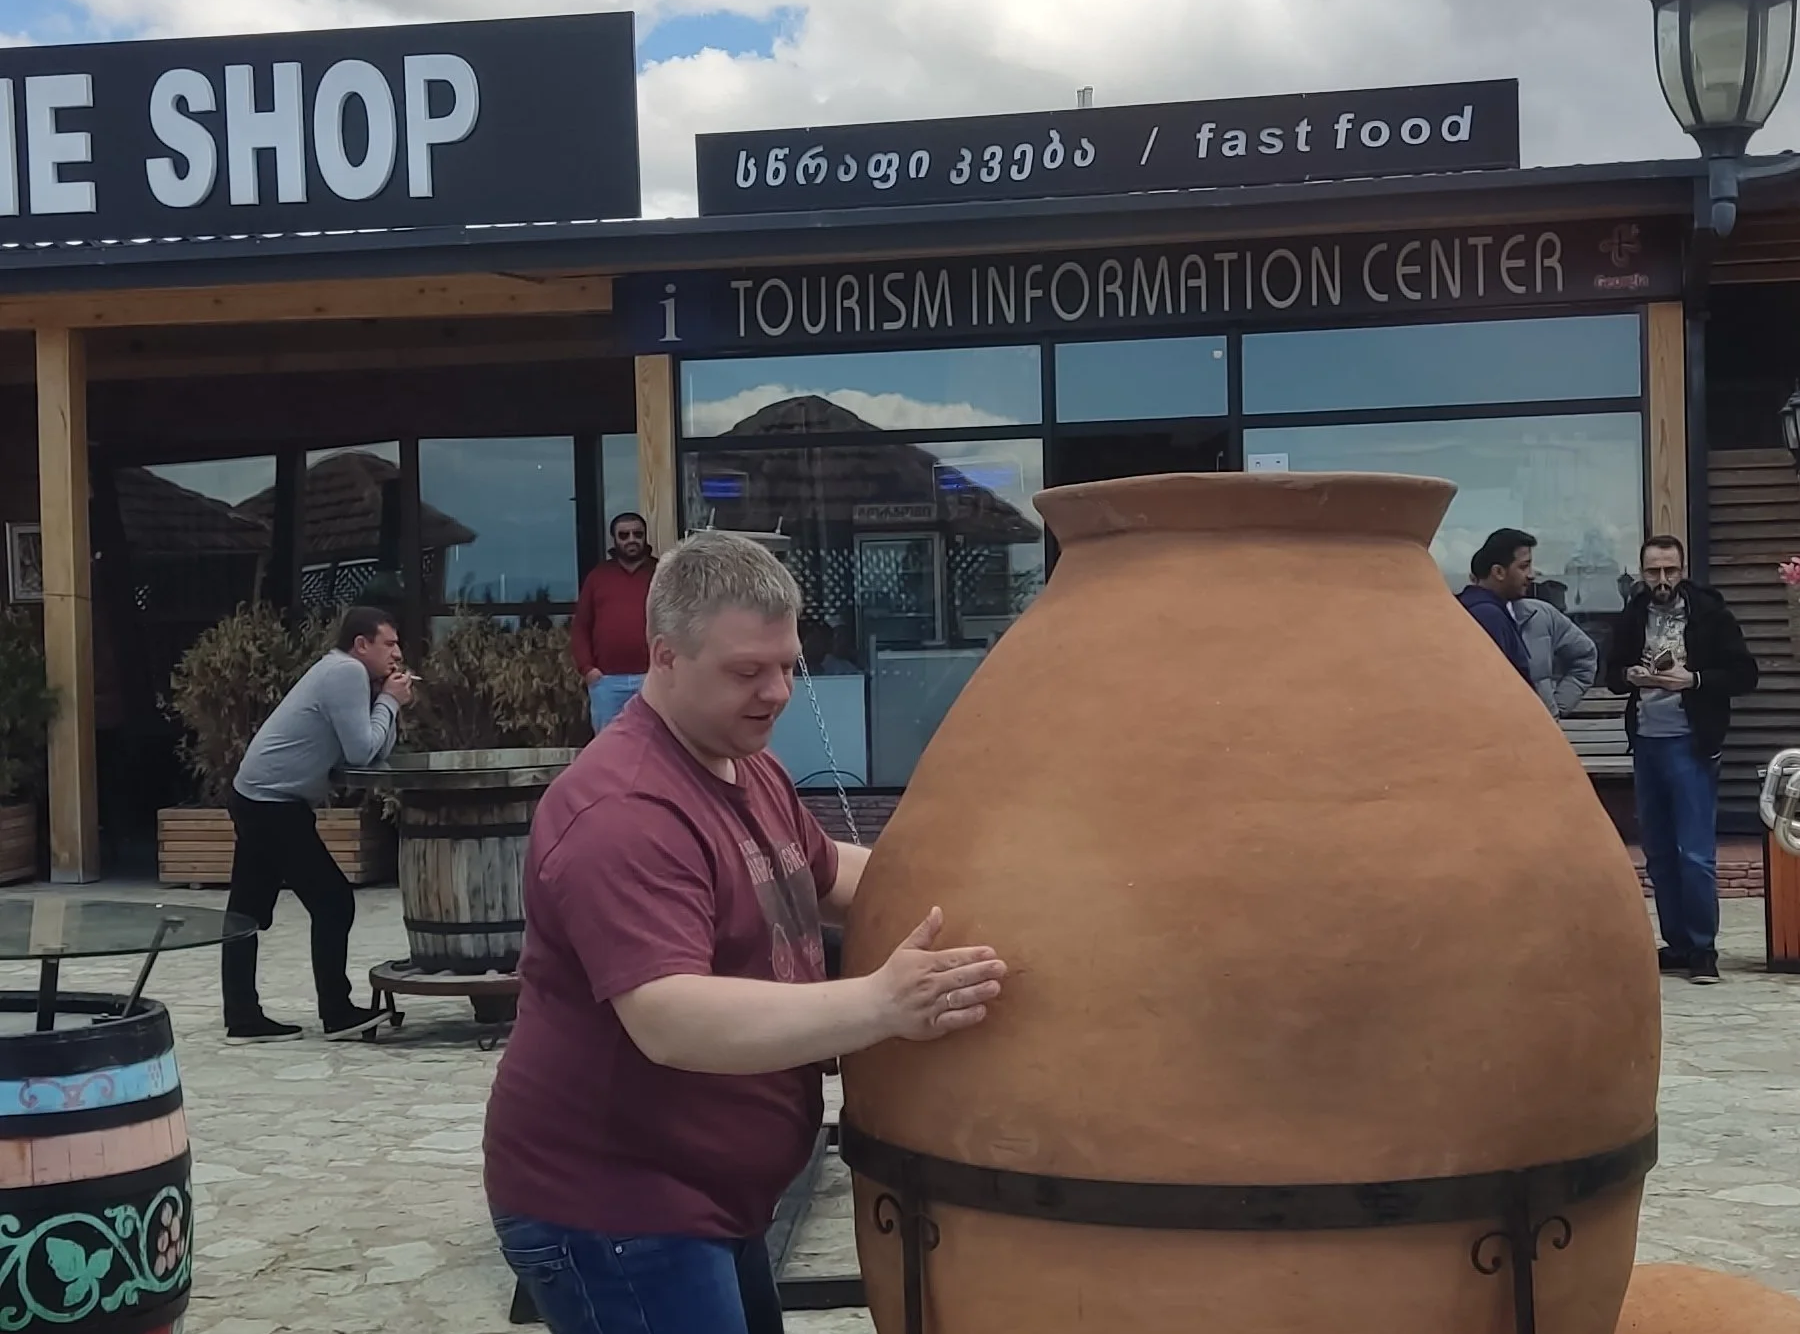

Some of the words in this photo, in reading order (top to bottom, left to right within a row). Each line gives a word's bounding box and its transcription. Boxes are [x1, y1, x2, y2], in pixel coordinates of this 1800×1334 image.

[145, 54, 479, 208] SHOP
[735, 145, 931, 189] სწრაფი
[949, 129, 1096, 185] კვება
[1196, 117, 1312, 158] fast
[1334, 105, 1473, 150] food
[730, 268, 953, 337] TOURISM
[970, 244, 1341, 326] INFORMATION
[1363, 232, 1564, 302] CENTER
